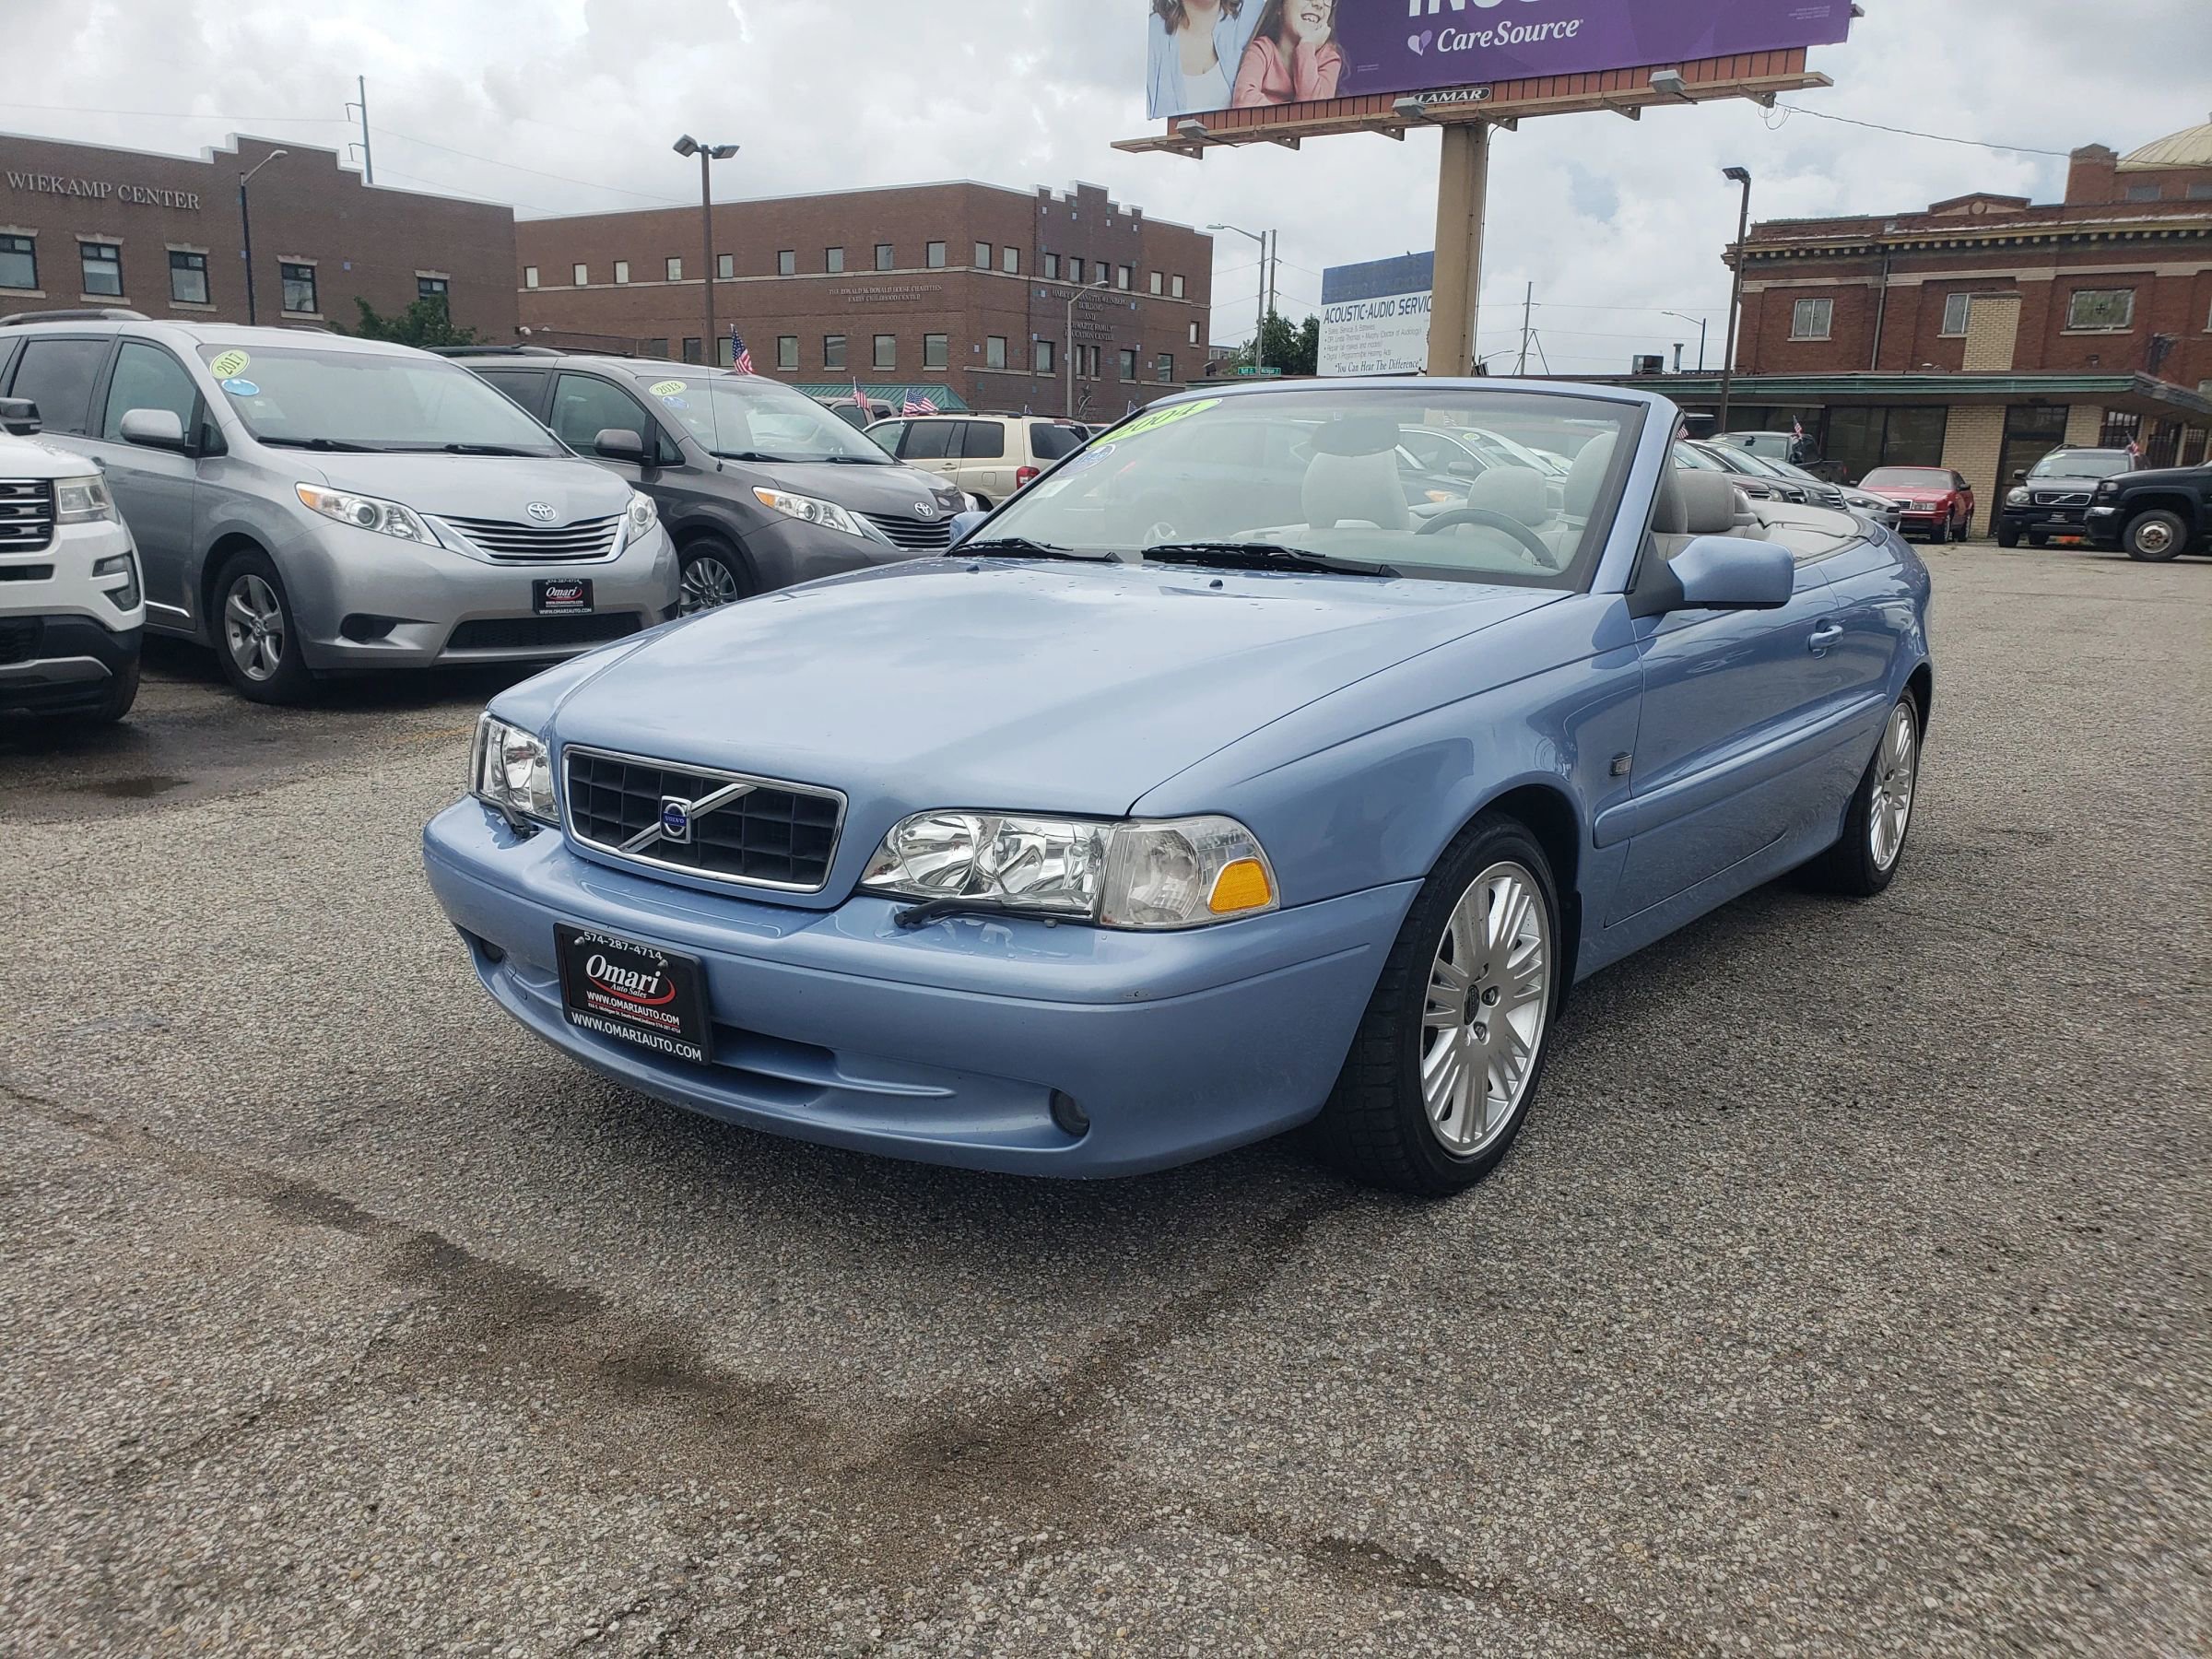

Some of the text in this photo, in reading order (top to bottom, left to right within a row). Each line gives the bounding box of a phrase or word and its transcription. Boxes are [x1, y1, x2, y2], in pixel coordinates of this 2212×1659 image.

[1418, 89, 1483, 103] LAMAR
[6, 171, 201, 210] WIEKAMP CENTER
[216, 352, 244, 375] 2017
[1376, 359, 1387, 371] The
[655, 382, 682, 395] 2013
[1107, 402, 1202, 442] 2004
[546, 586, 578, 597] Omari
[665, 815, 685, 824] VOLVO
[583, 931, 664, 960] 574-287-4714
[585, 954, 661, 994] Omari
[610, 982, 648, 999] Auto Sales
[586, 990, 680, 1026] WWW.OMARIAUTO.COM
[571, 1012, 702, 1062] WWW.OMARIAUTO.COM
